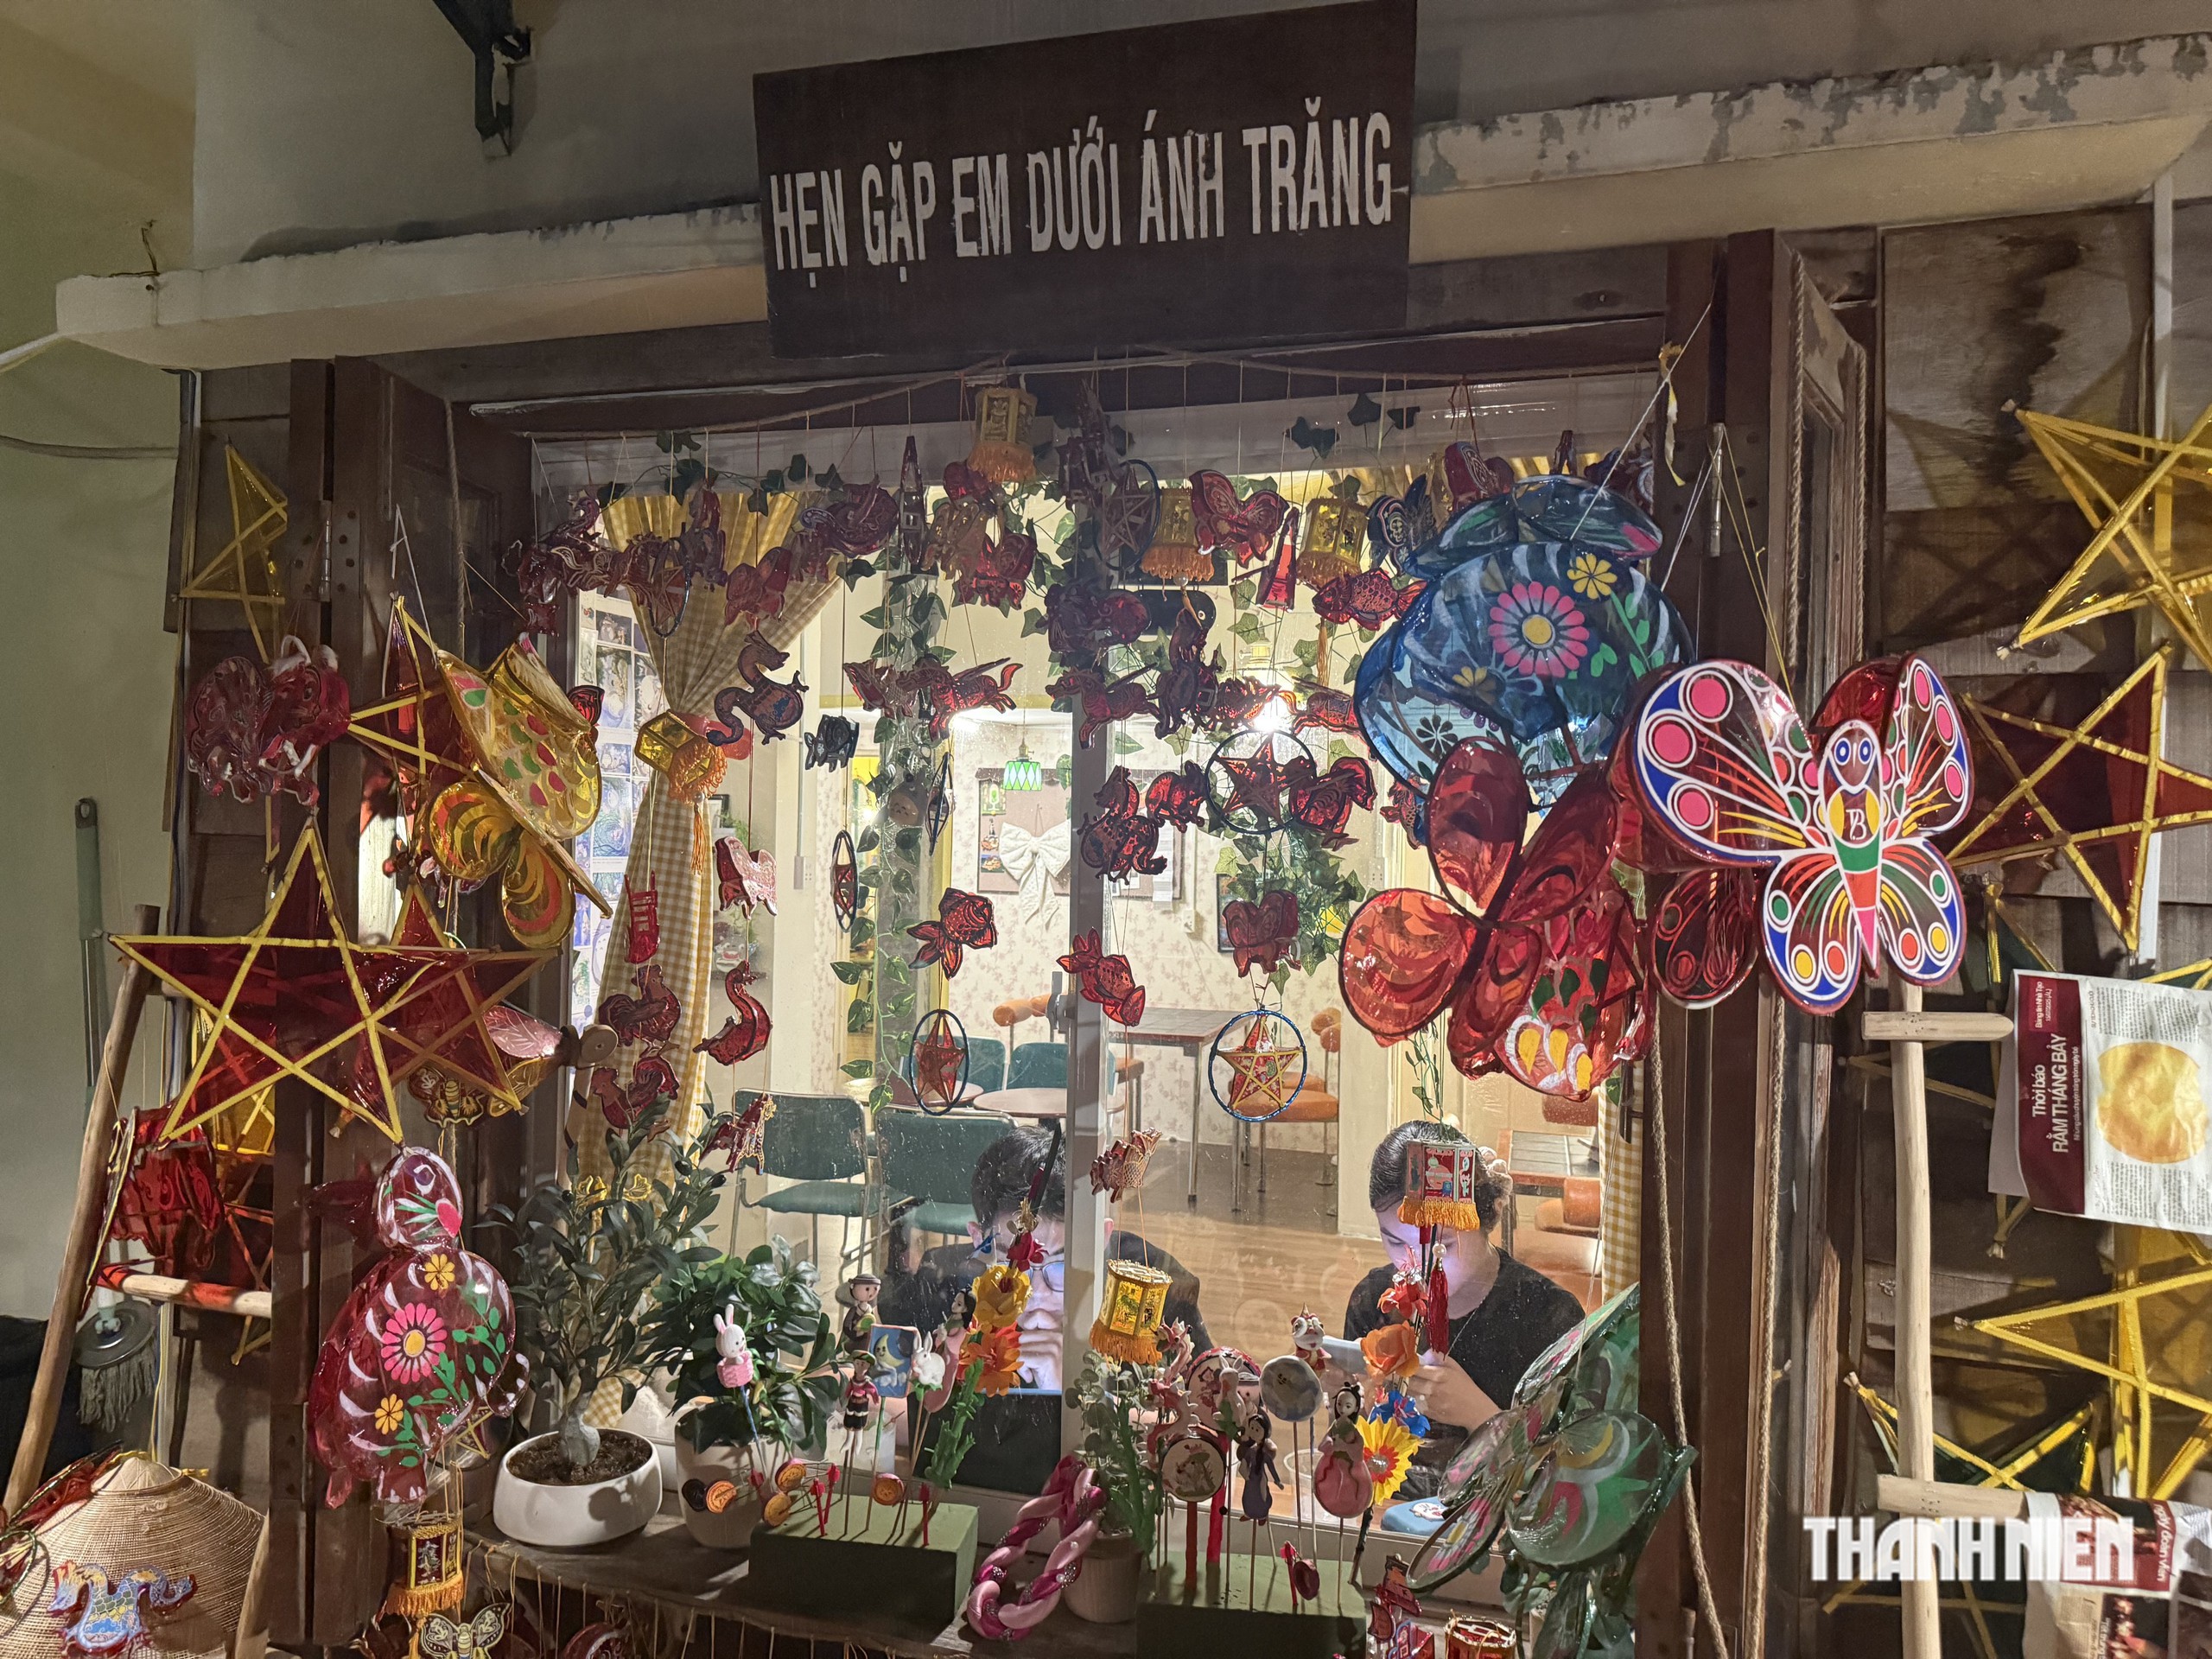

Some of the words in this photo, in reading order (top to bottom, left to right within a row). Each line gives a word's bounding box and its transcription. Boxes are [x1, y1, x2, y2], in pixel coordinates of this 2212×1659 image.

[769, 168, 848, 288] HẸN
[861, 141, 936, 283] GẶP
[951, 153, 1012, 257] EM
[1027, 115, 1121, 252] DƯỚI
[1140, 110, 1224, 244] ÁNH
[1242, 97, 1391, 235] TRĂNG
[2046, 1033, 2067, 1063] BẢY
[2031, 1065, 2046, 1088] báo
[2047, 1065, 2069, 1116] THÁNG
[2031, 1090, 2046, 1117] Thời
[2046, 1118, 2069, 1153] RẰM
